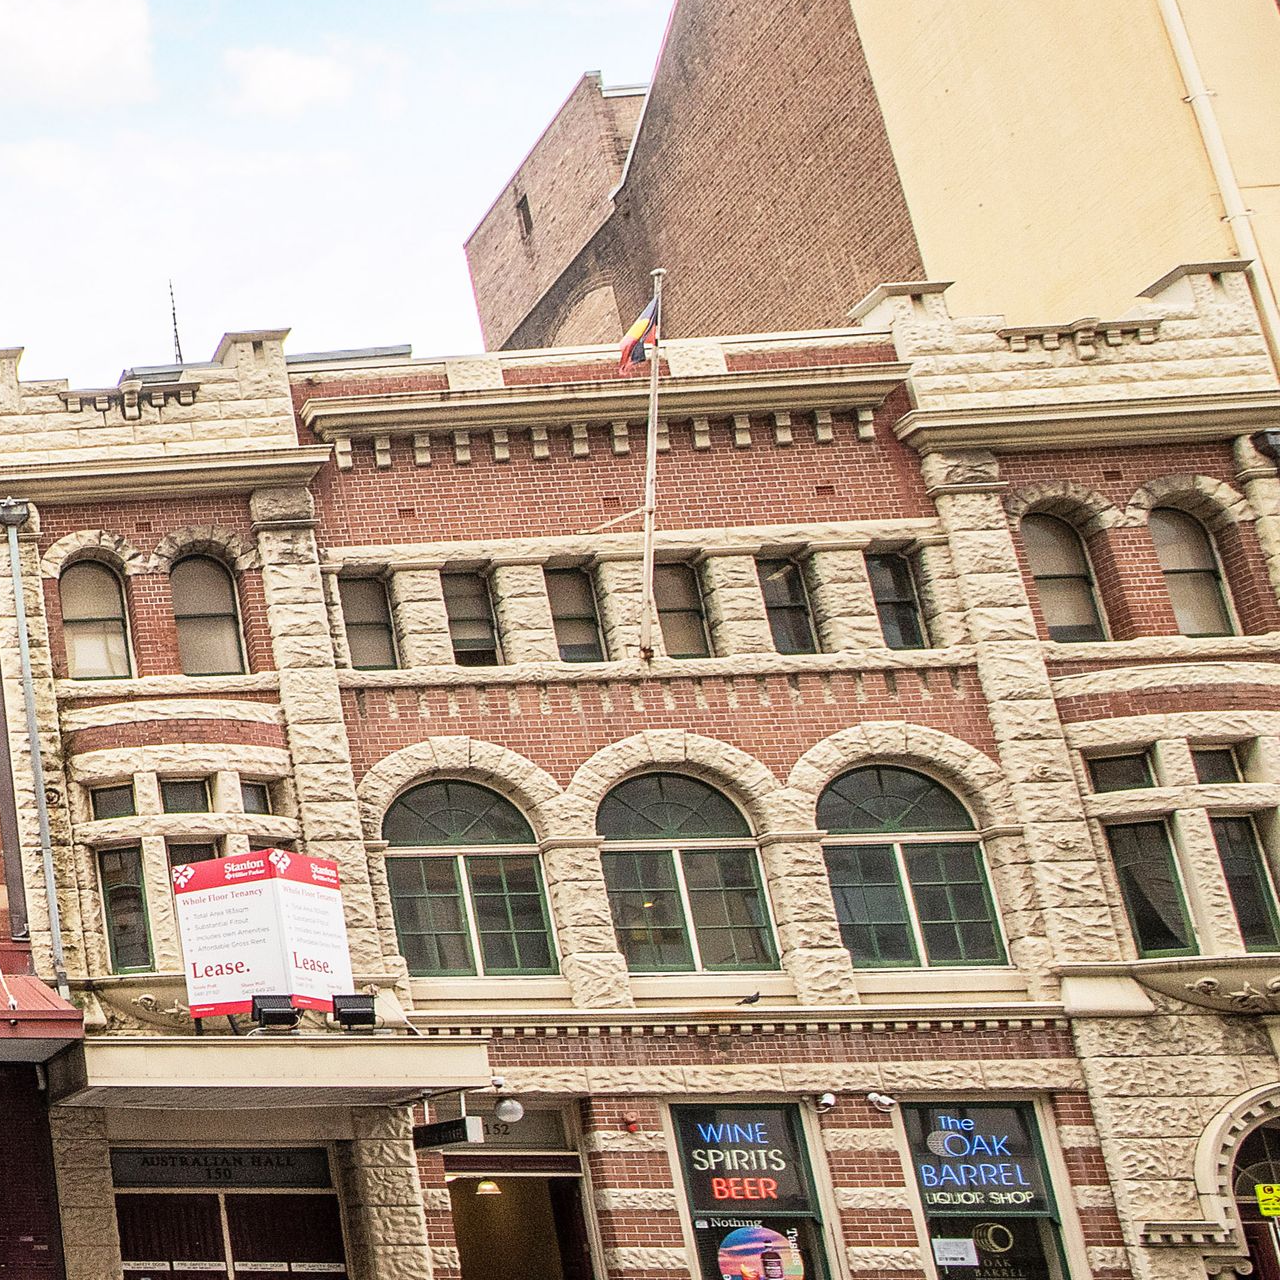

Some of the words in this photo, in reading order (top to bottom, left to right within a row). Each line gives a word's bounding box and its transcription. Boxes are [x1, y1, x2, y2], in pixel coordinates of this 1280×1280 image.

[224, 859, 265, 873] Stanton
[208, 893, 228, 902] Floor
[230, 888, 263, 899] Tenancy
[191, 960, 251, 979] Lease.
[293, 951, 334, 975] Lease.
[484, 1124, 511, 1135] 152
[937, 1115, 975, 1131] The
[696, 1123, 769, 1144] WINE
[944, 1133, 1012, 1157] OAK
[140, 1155, 244, 1167] AUSTRALIAN
[250, 1154, 295, 1167] HALL
[692, 1149, 786, 1171] SPIRITS
[206, 1168, 233, 1180] 150
[921, 1163, 1031, 1187] BARREL
[712, 1177, 778, 1200] BEER
[925, 1192, 984, 1205] LIQUOR
[988, 1191, 1035, 1205] SHOP
[710, 1218, 763, 1229] Nothing
[983, 1258, 1012, 1267] OAK
[975, 1268, 1027, 1277] BARREL
